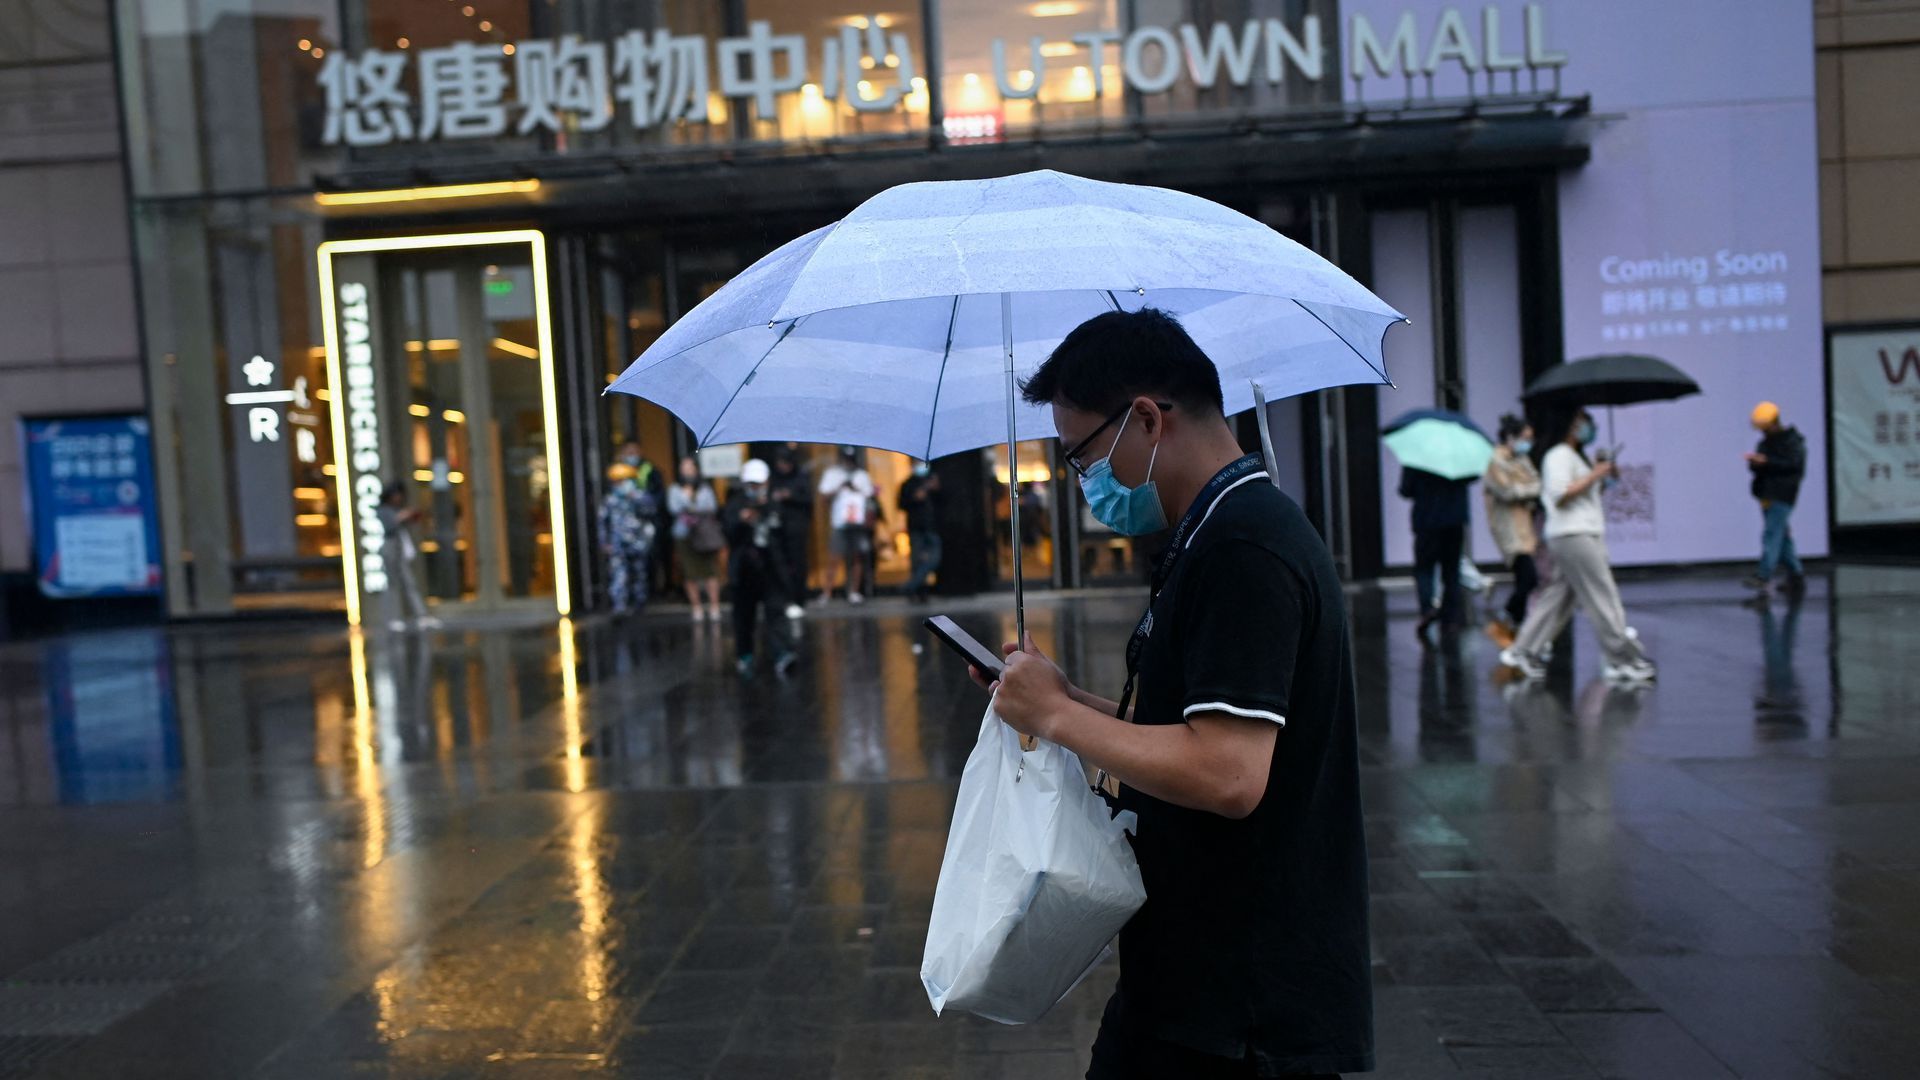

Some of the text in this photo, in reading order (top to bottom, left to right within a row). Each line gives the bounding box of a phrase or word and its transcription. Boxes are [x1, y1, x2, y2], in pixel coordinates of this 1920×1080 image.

[317, 21, 912, 146] 悠唐购物中心
[992, 3, 1569, 100] U TOWN MALL
[1600, 248, 1788, 284] Coming Soon
[248, 407, 280, 442] R
[340, 282, 389, 593] STARBUCKS COFFEE
[1173, 513, 1192, 549] SINOPEC
